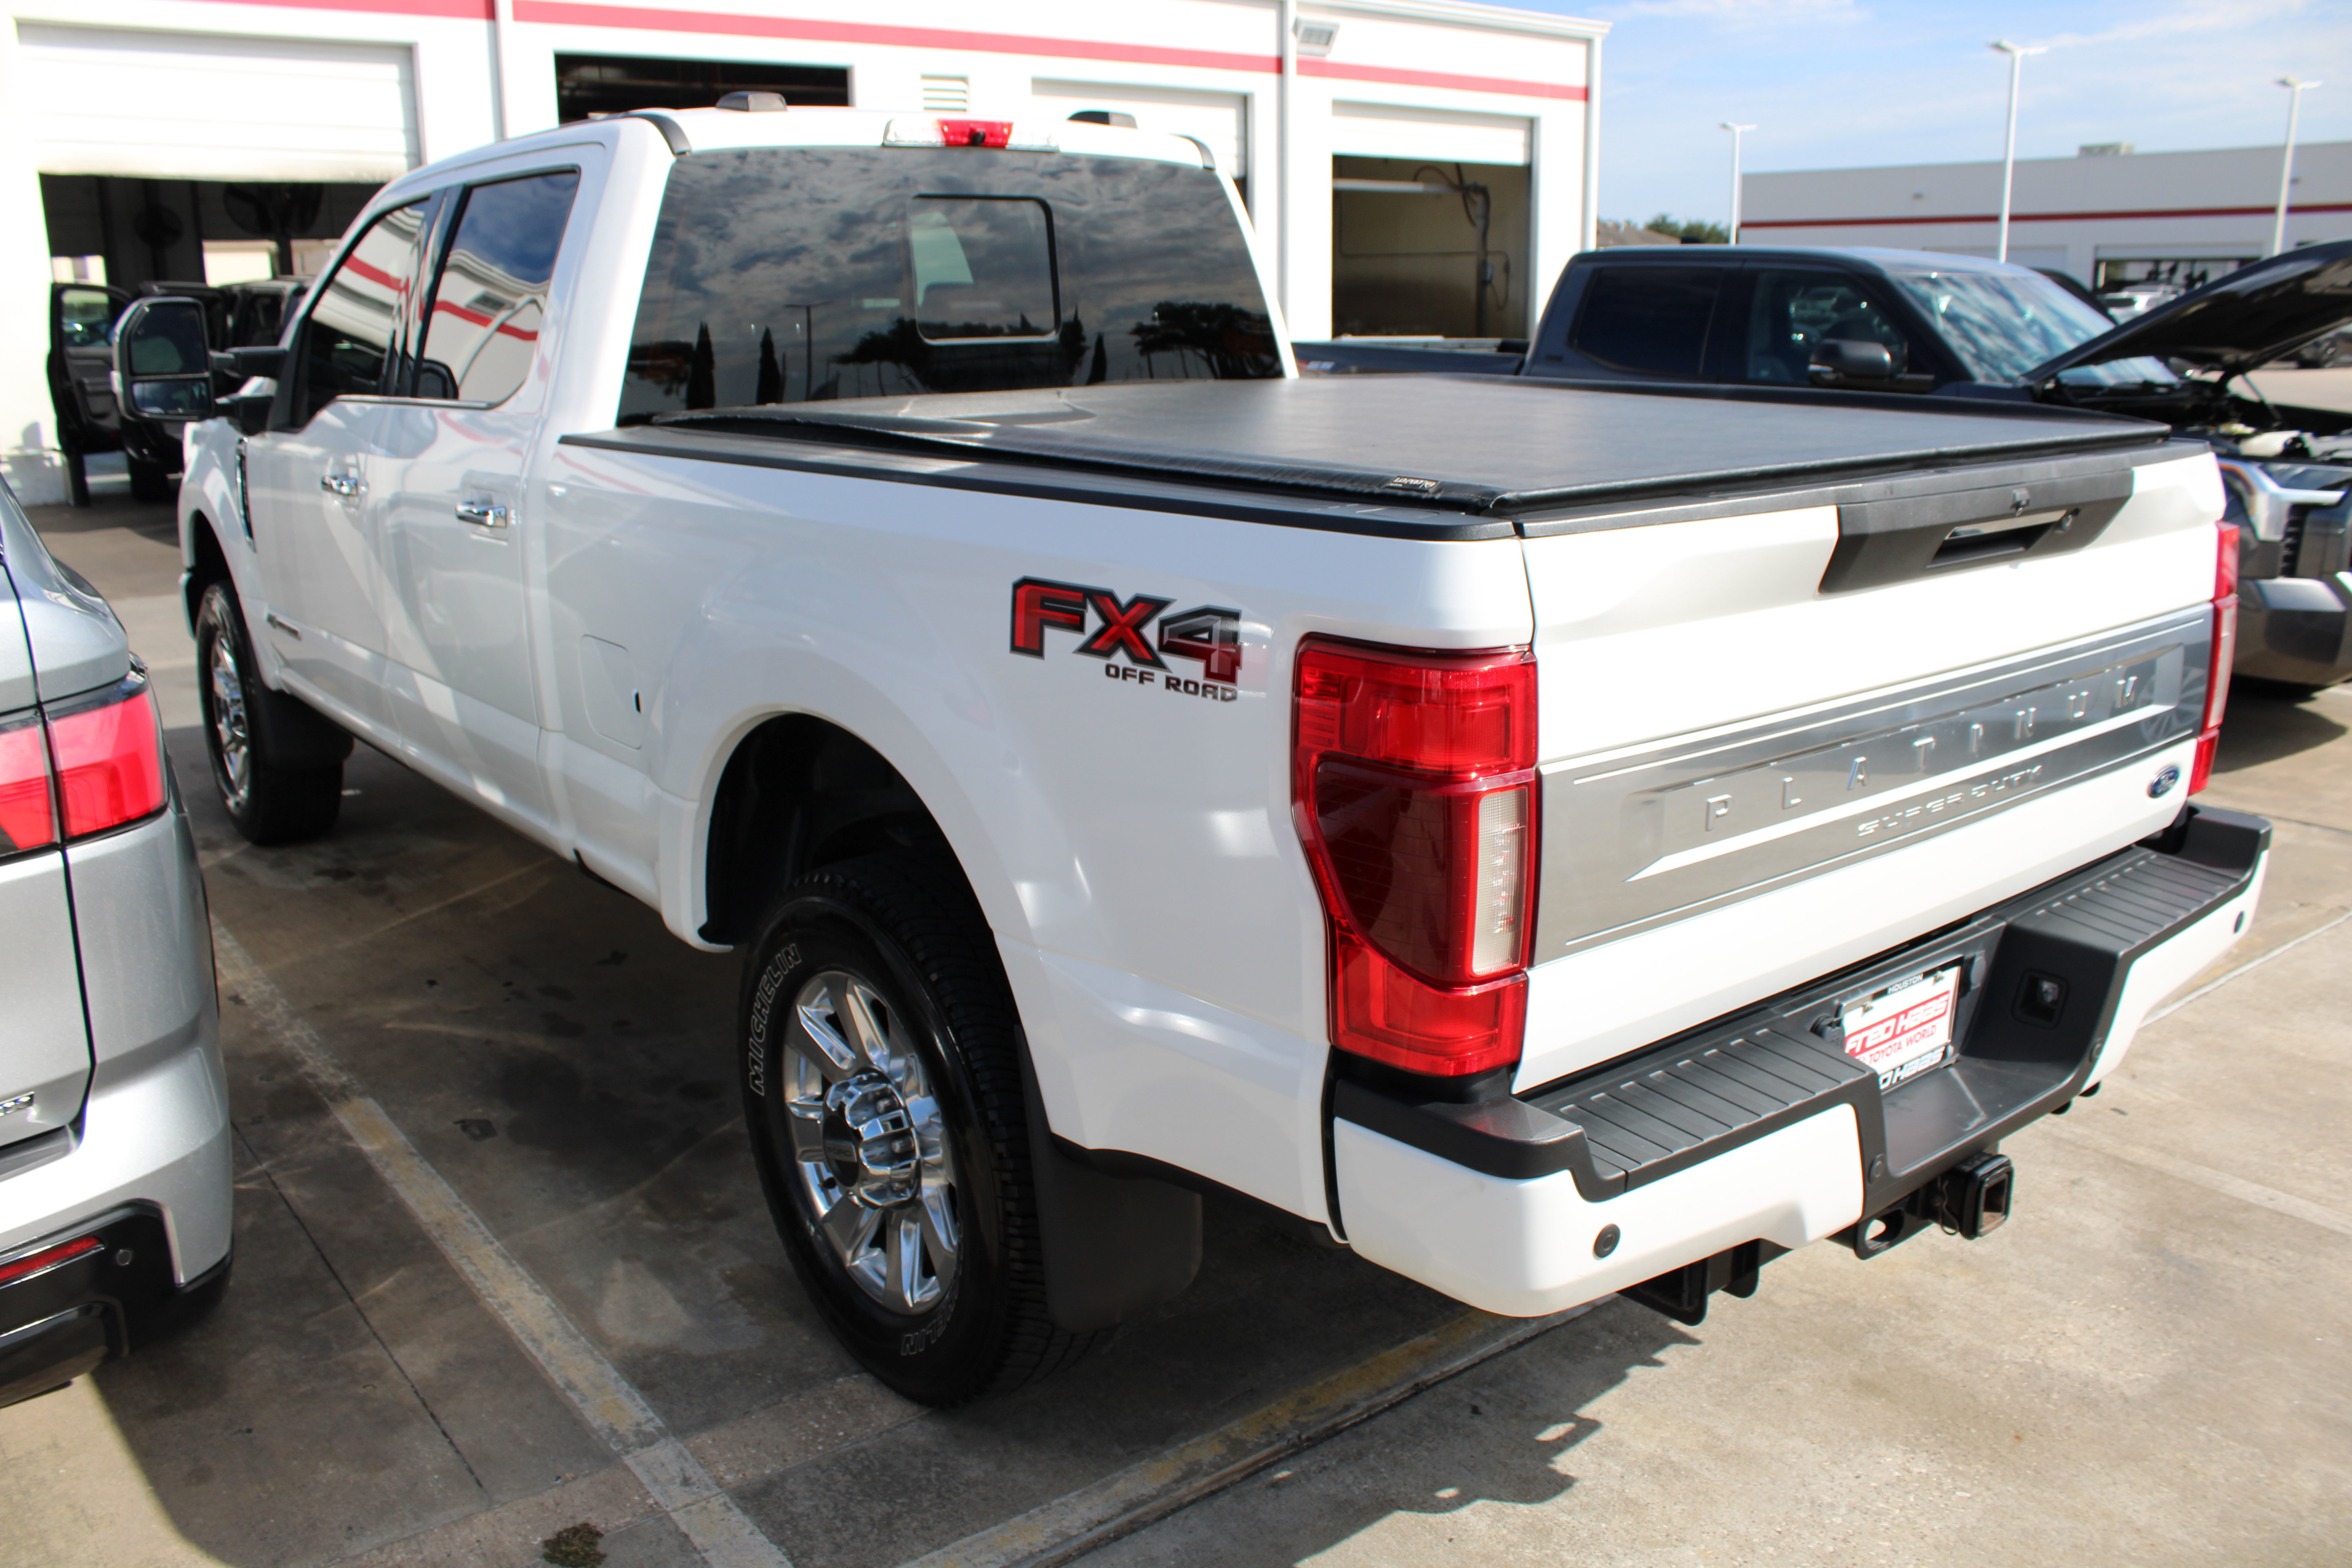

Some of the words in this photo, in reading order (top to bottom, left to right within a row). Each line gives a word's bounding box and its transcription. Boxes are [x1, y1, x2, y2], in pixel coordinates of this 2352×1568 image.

[1009, 575, 1242, 686] FX4
[1105, 663, 1155, 685] OFF
[1165, 675, 1238, 703] ROAD
[1704, 675, 2139, 831] PLATINUM
[1858, 793, 1965, 837] SUPER
[1970, 765, 2042, 798] DUTY
[748, 943, 802, 1096] MICHELIN
[1888, 974, 1923, 993] HOUSTON
[1870, 1042, 1902, 1064] TOYOTA
[1906, 1025, 1936, 1046] WORLD
